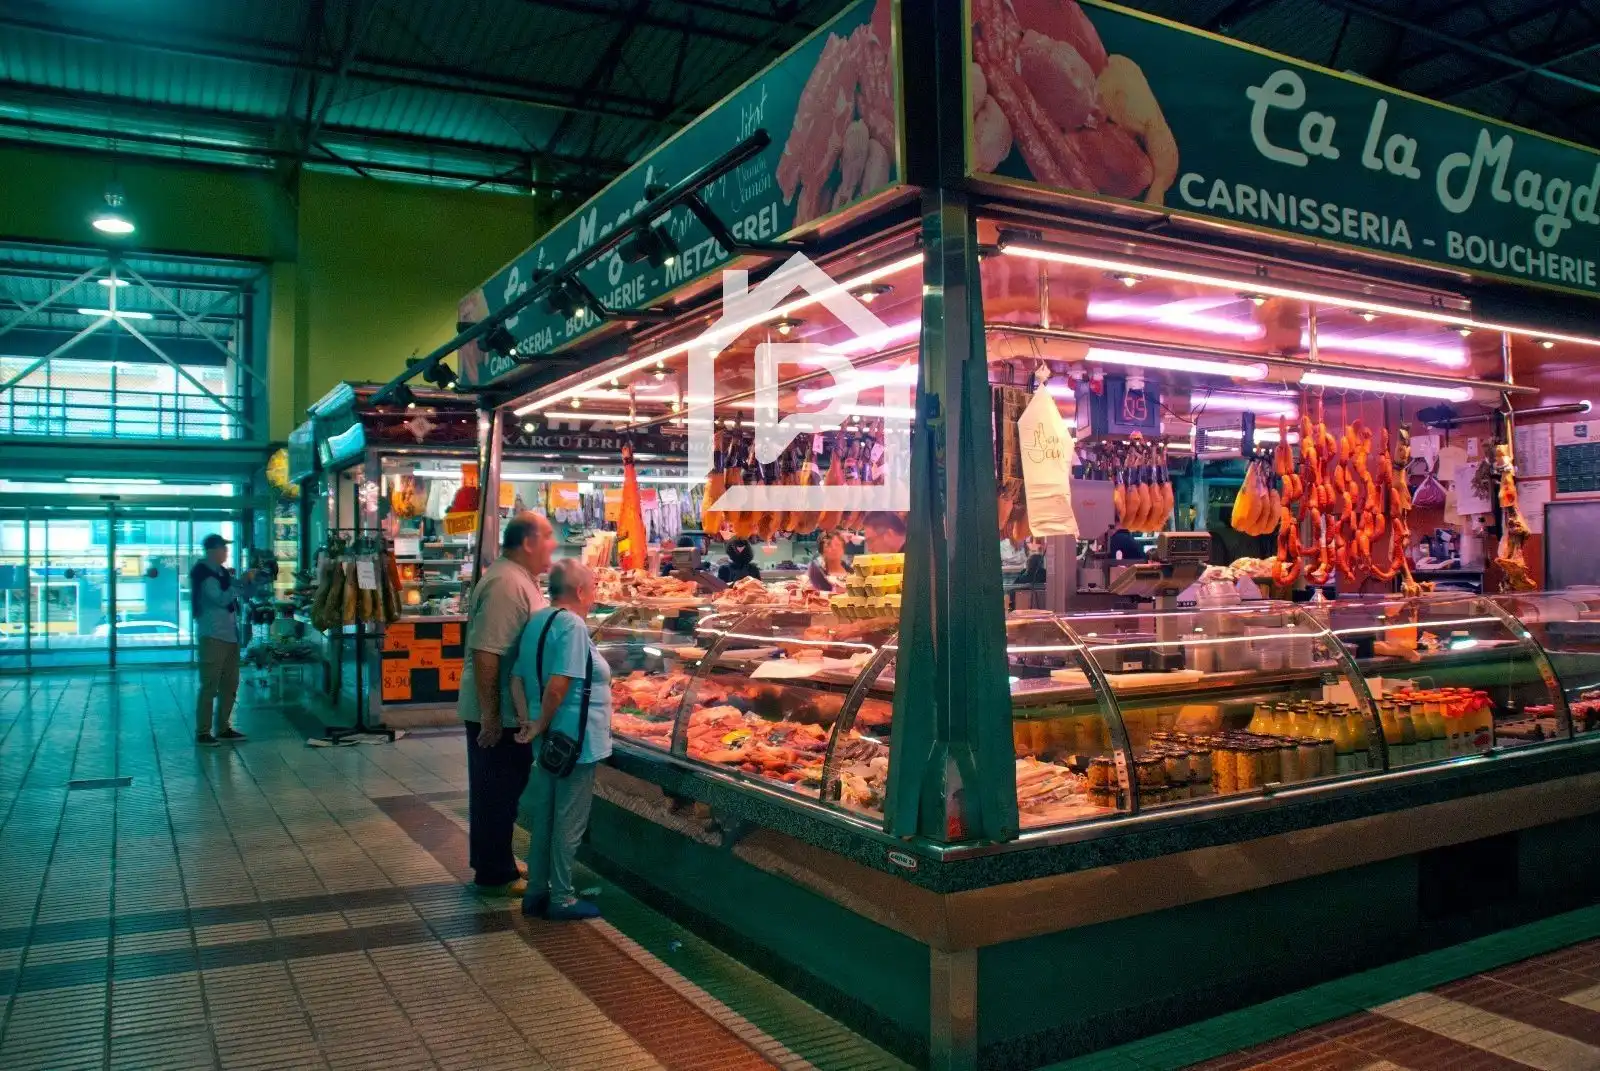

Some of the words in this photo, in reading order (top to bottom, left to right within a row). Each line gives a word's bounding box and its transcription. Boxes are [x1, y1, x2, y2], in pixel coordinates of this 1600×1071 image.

[1245, 68, 1340, 166] Ca
[1361, 97, 1421, 180] la
[1179, 172, 1413, 250] CARNISSERIA
[1447, 230, 1597, 287] BOUCHERIE
[489, 326, 553, 376] CARNSSERIA
